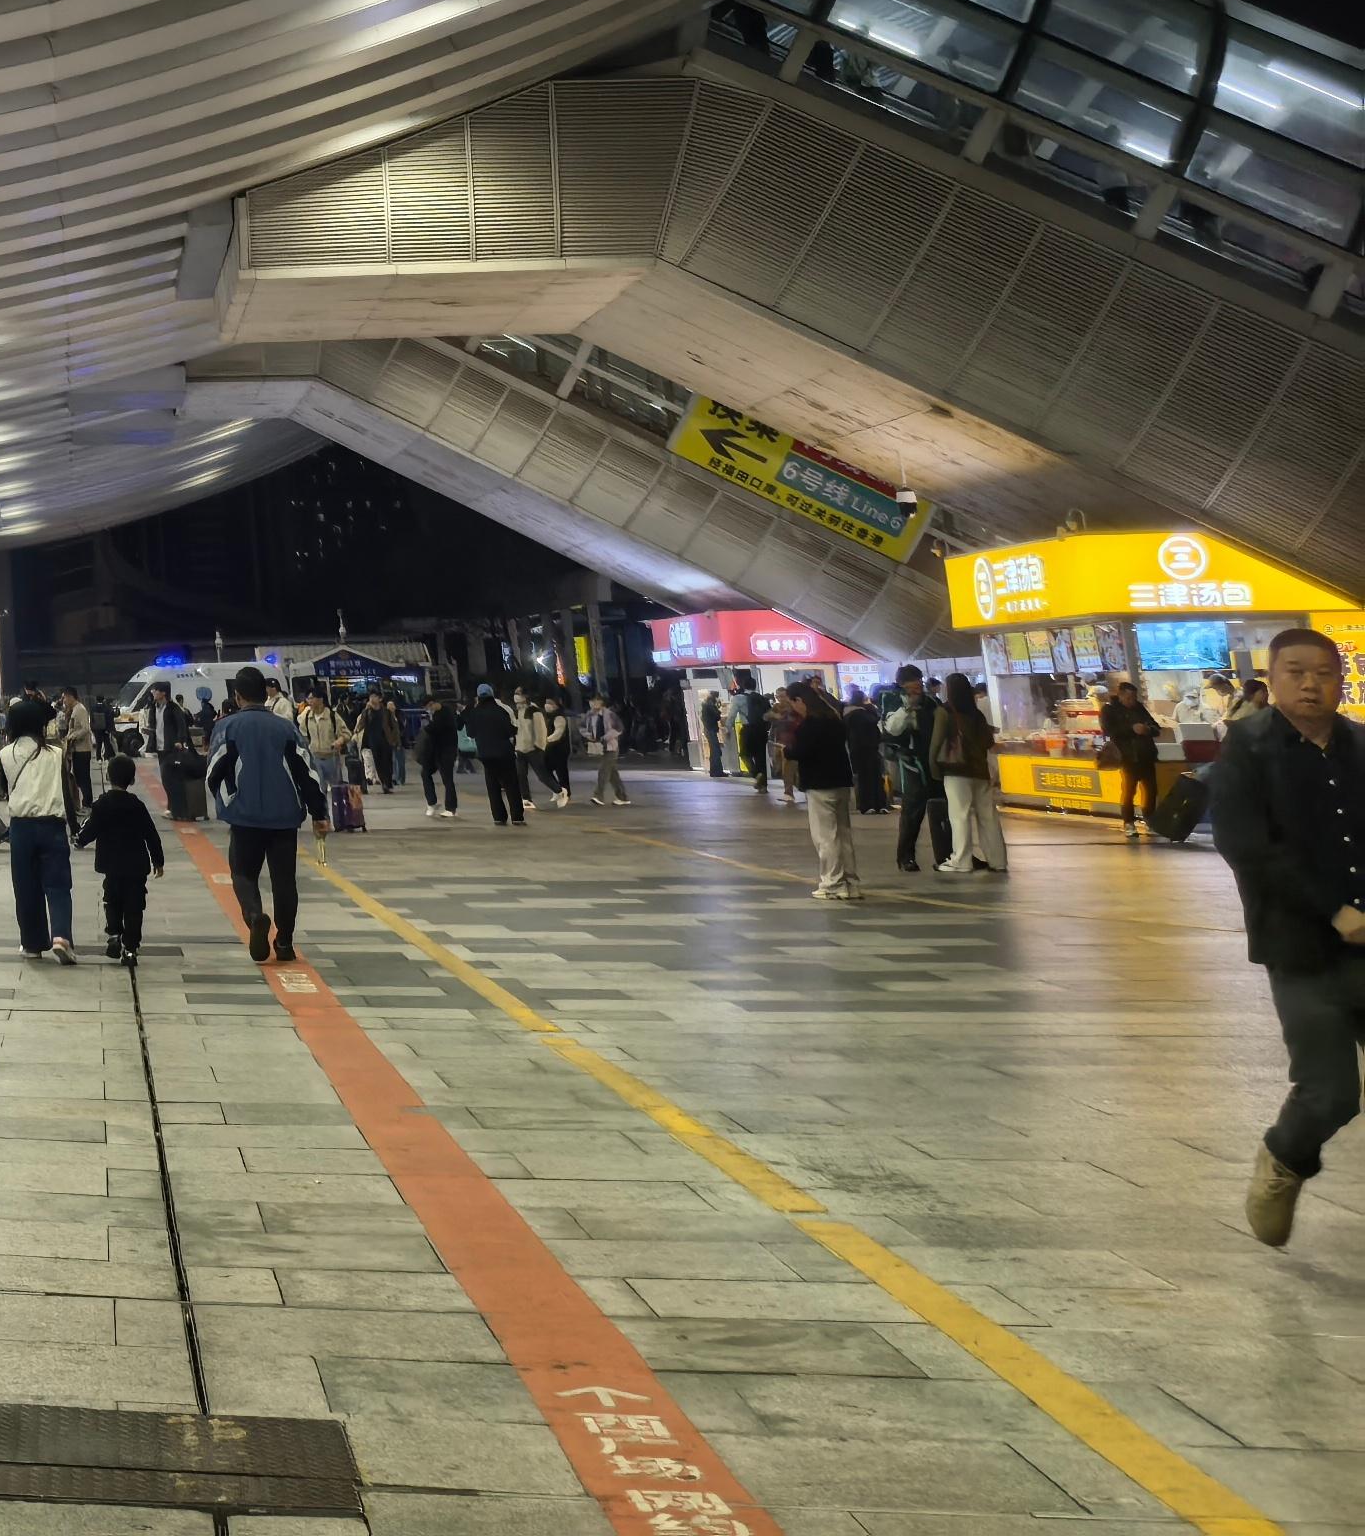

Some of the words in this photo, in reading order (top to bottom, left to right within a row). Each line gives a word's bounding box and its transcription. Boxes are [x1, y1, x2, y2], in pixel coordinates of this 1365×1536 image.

[782, 460, 851, 507] 6号线
[851, 494, 890, 526] Line
[890, 513, 903, 530] 6
[1128, 582, 1252, 607] 三津汤包
